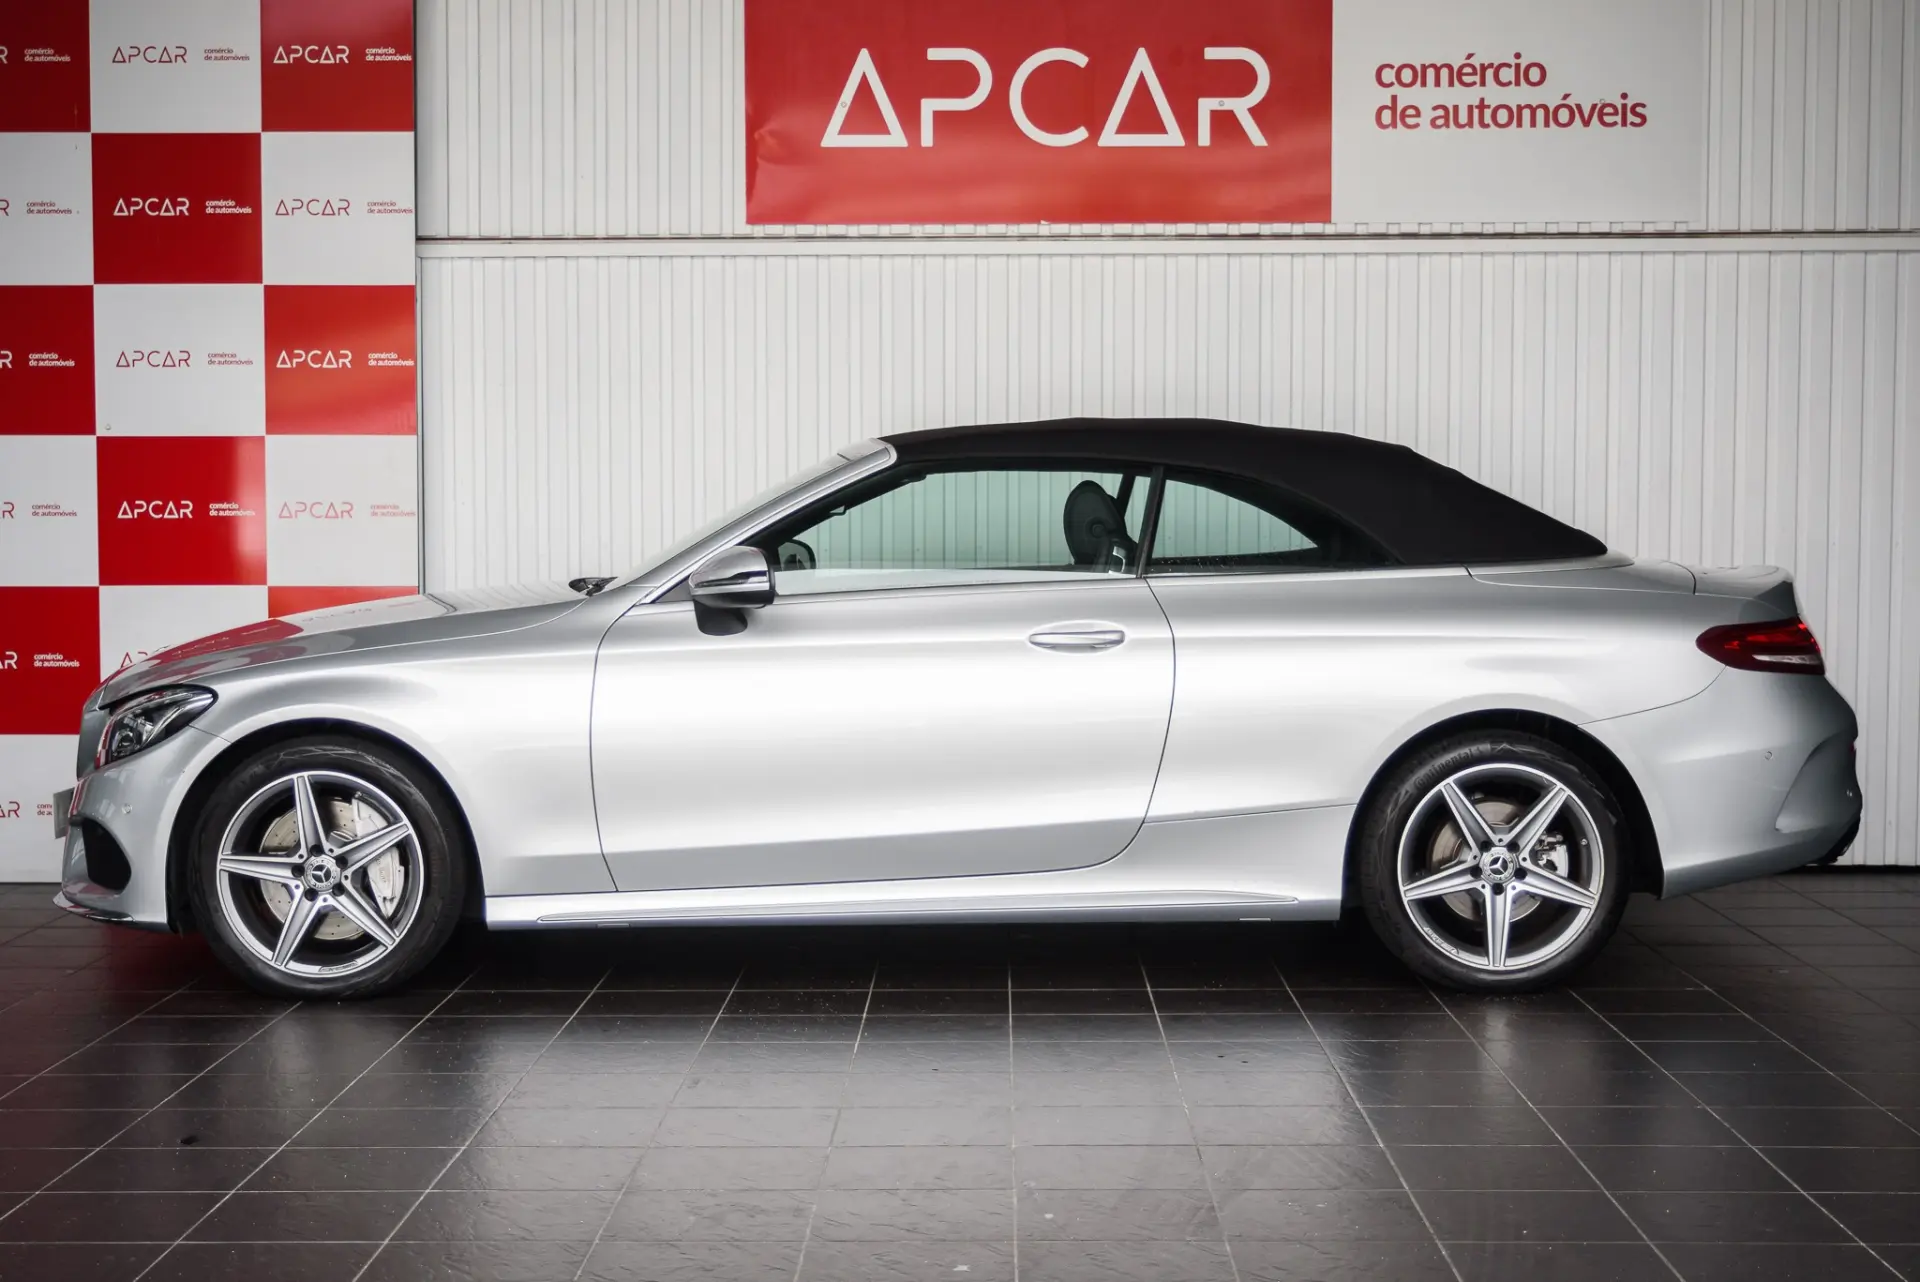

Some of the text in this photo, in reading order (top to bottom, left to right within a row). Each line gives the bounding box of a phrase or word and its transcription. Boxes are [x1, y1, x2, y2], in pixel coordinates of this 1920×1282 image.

[112, 46, 187, 64] APCAR
[273, 45, 349, 64] APCAR
[1375, 52, 1547, 88] comércio
[820, 47, 1270, 147] APCAR
[1375, 92, 1647, 129] de automóveis
[114, 198, 190, 216] APCAR
[275, 198, 351, 217] APCAR
[116, 351, 191, 368] APCAR
[276, 350, 352, 369] APCAR
[118, 500, 193, 519] APCAR
[278, 501, 354, 519] APCAR
